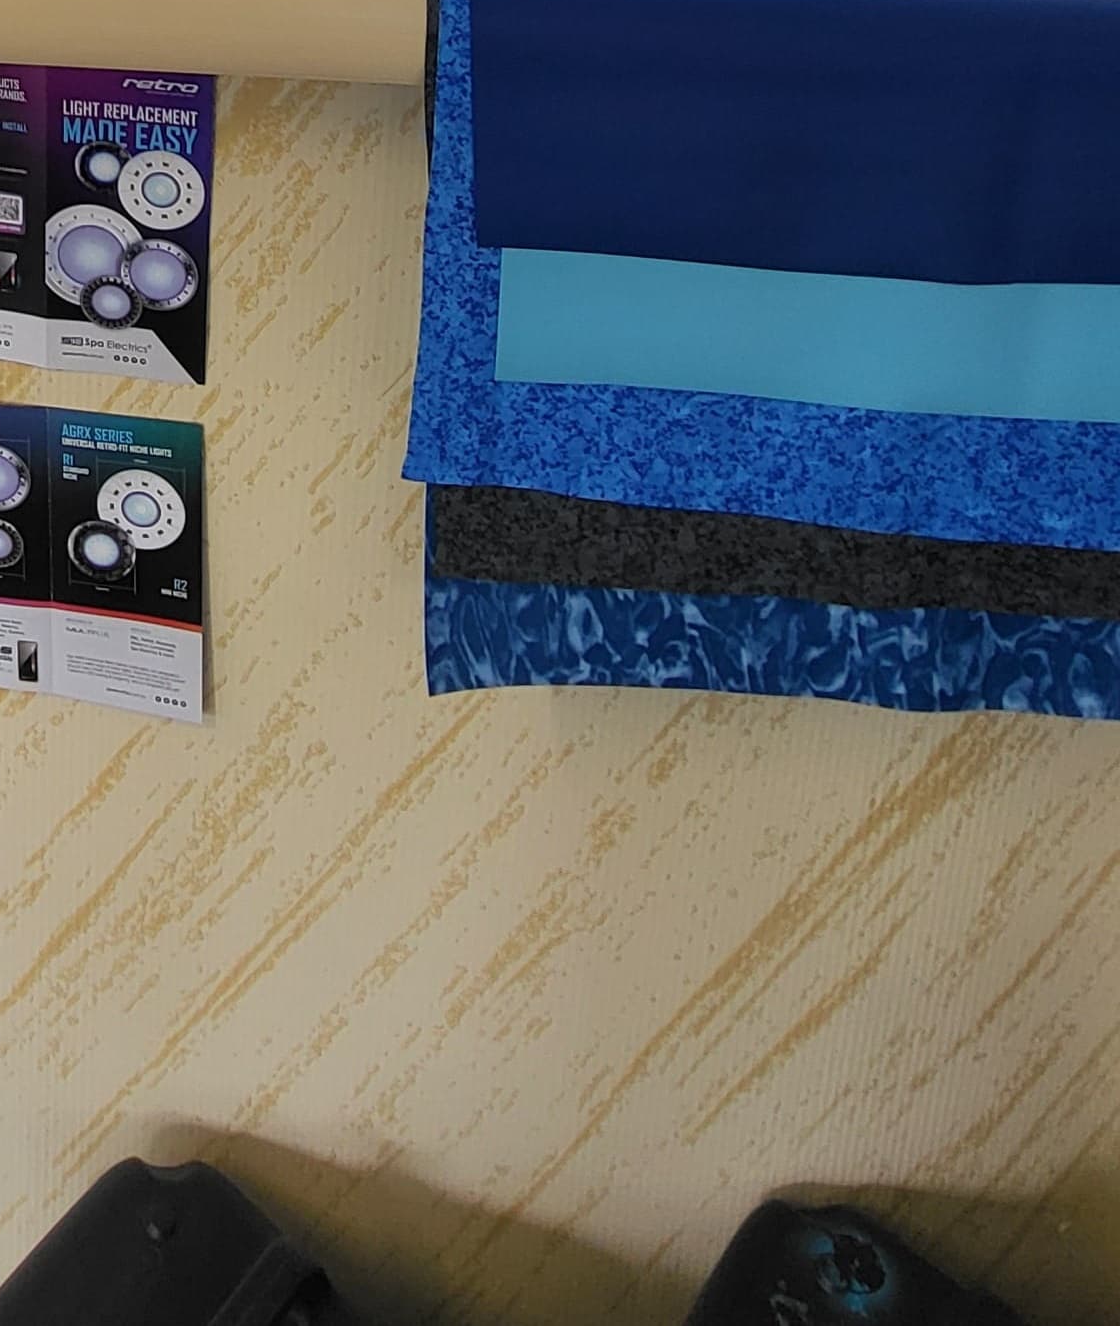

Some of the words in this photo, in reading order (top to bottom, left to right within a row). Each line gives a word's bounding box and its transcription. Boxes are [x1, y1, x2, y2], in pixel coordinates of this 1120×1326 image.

[122, 78, 199, 93] retro
[63, 99, 100, 118] LIGHT
[103, 103, 198, 128] REPLACEMENT
[63, 116, 129, 149] MADE
[135, 122, 197, 154] EASY
[85, 337, 104, 348] Spa
[62, 423, 93, 440] AGRX
[94, 427, 134, 445] SERIES
[61, 438, 96, 451] UNIVERSAL
[129, 444, 148, 455] NICHE
[149, 446, 172, 458] LIGHTS
